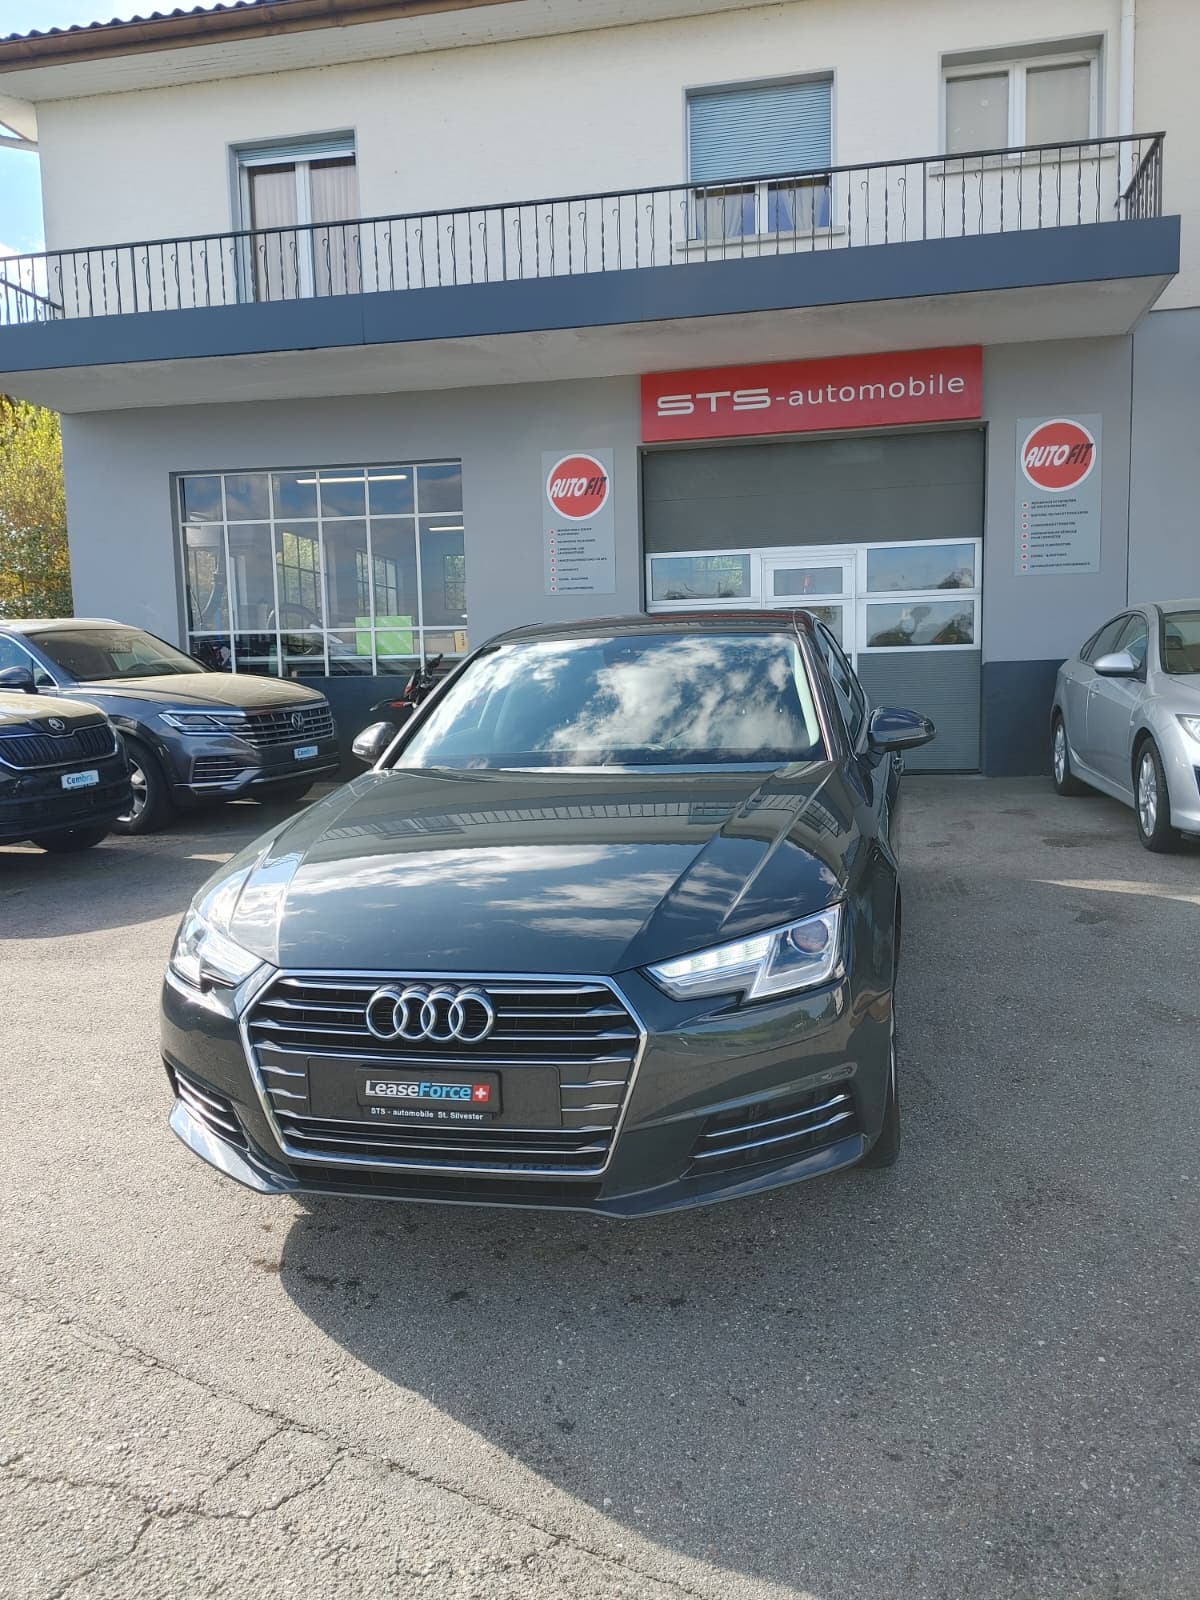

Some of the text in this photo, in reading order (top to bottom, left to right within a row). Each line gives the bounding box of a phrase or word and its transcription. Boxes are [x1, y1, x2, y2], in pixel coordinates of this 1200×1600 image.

[1025, 443, 1093, 468] AUTOFIT
[550, 477, 607, 498] AUTOFIT
[365, 1079, 472, 1100] LeaseForce
[371, 1107, 386, 1115] STS
[392, 1109, 434, 1119] automobile
[438, 1111, 449, 1119] St.
[450, 1111, 484, 1121] Silvester
